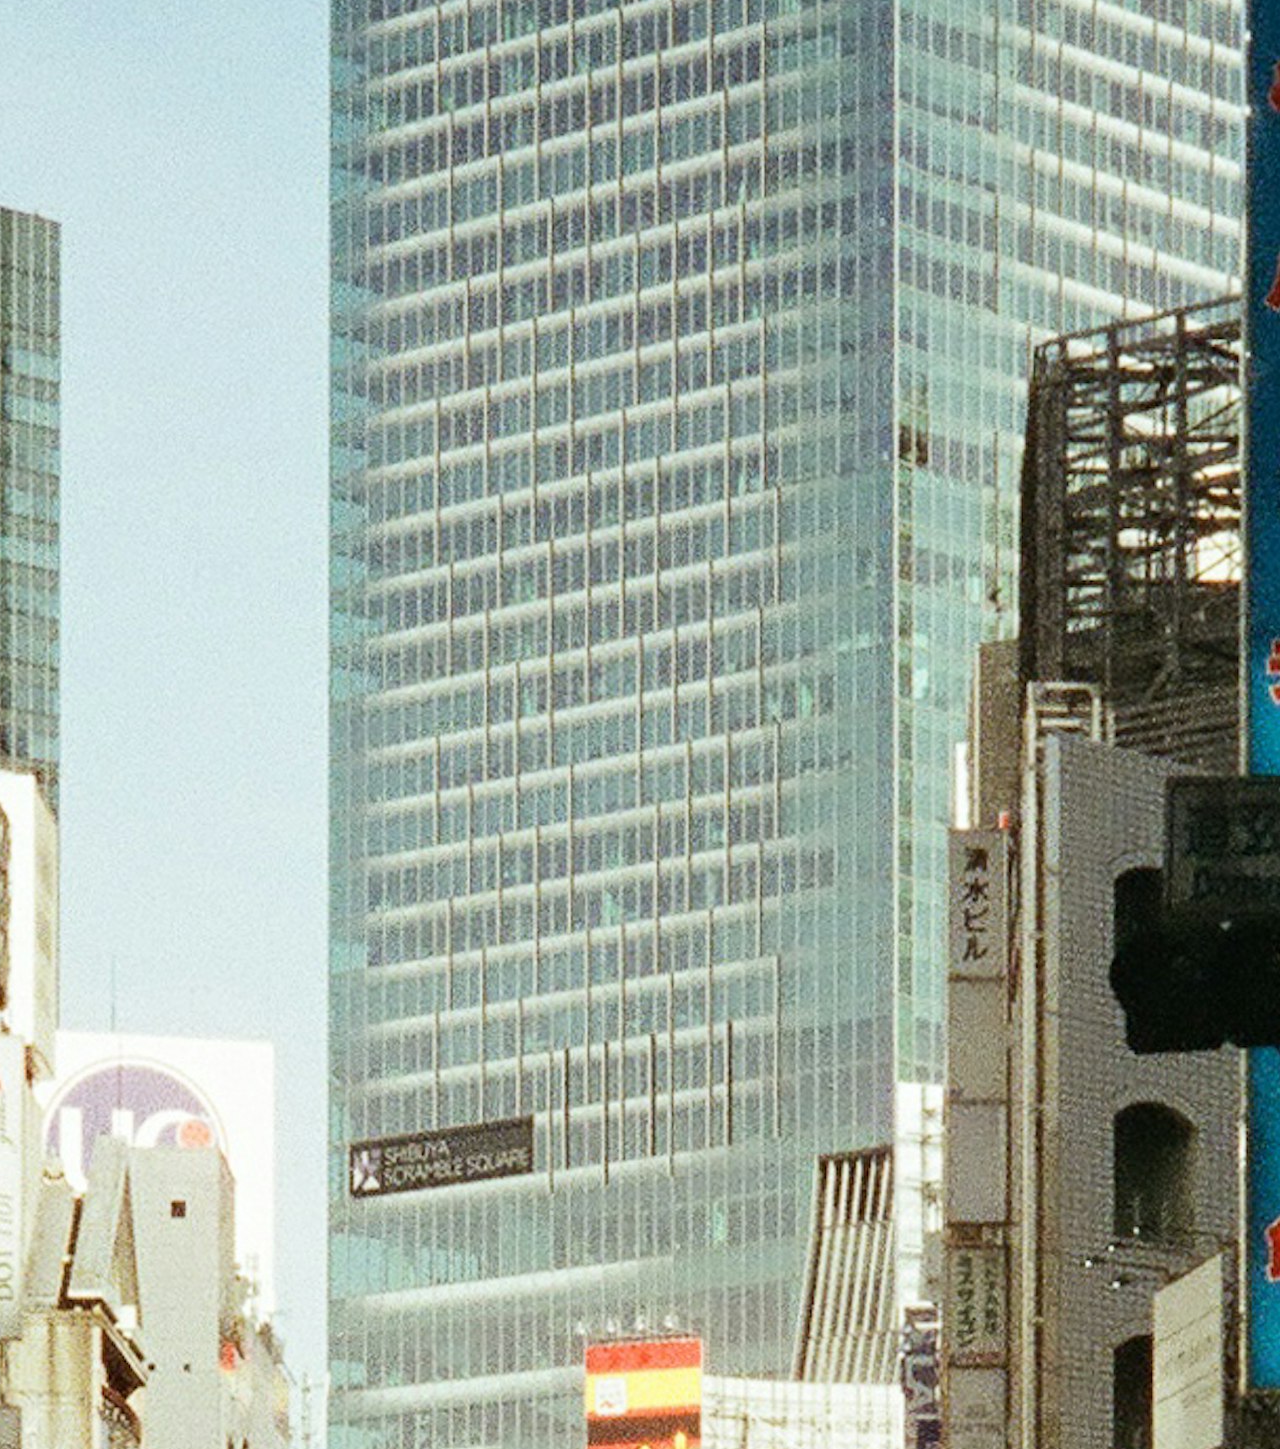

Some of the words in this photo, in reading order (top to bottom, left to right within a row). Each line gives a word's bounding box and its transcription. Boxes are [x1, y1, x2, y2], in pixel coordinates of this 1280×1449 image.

[384, 1140, 451, 1165] SHIBUYA
[384, 1156, 464, 1187] SCRAMBLE
[466, 1147, 529, 1175] SQUARE
